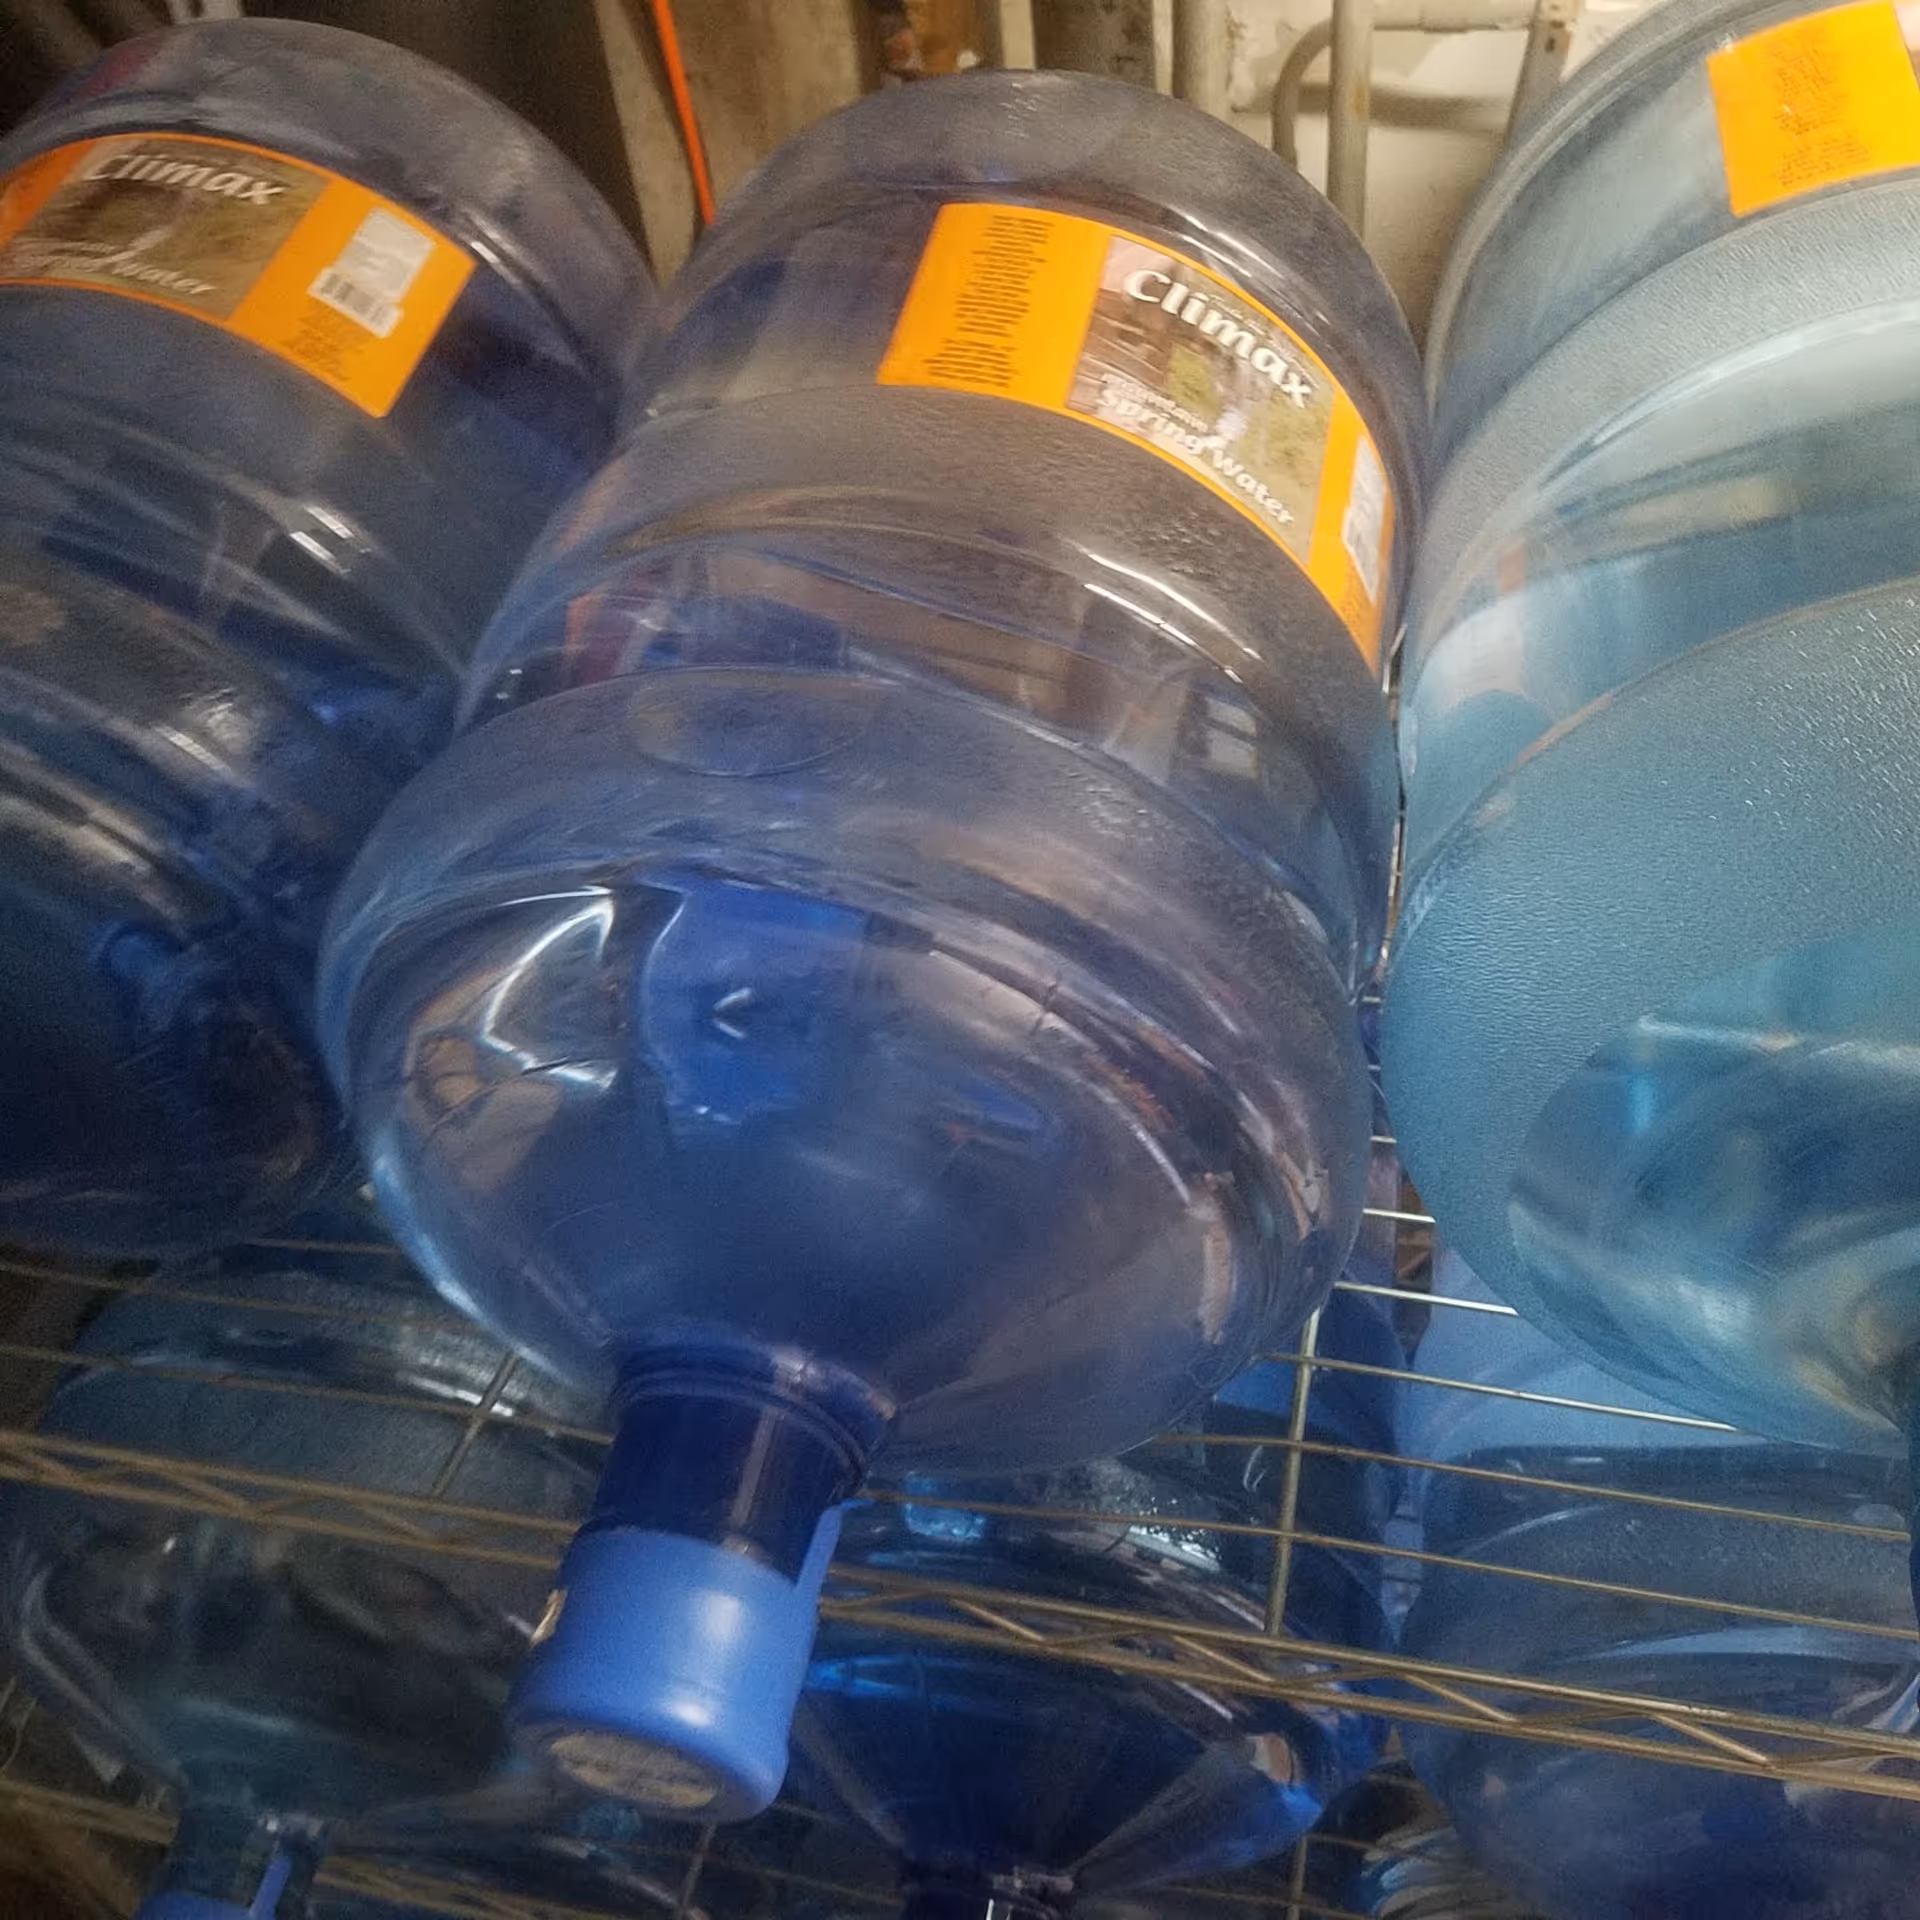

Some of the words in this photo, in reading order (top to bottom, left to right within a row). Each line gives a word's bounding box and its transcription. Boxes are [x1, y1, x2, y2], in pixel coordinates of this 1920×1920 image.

[83, 153, 286, 205] Climax
[1123, 269, 1312, 409] Climax
[1096, 388, 1203, 456] Spring
[1212, 449, 1294, 524] Water
